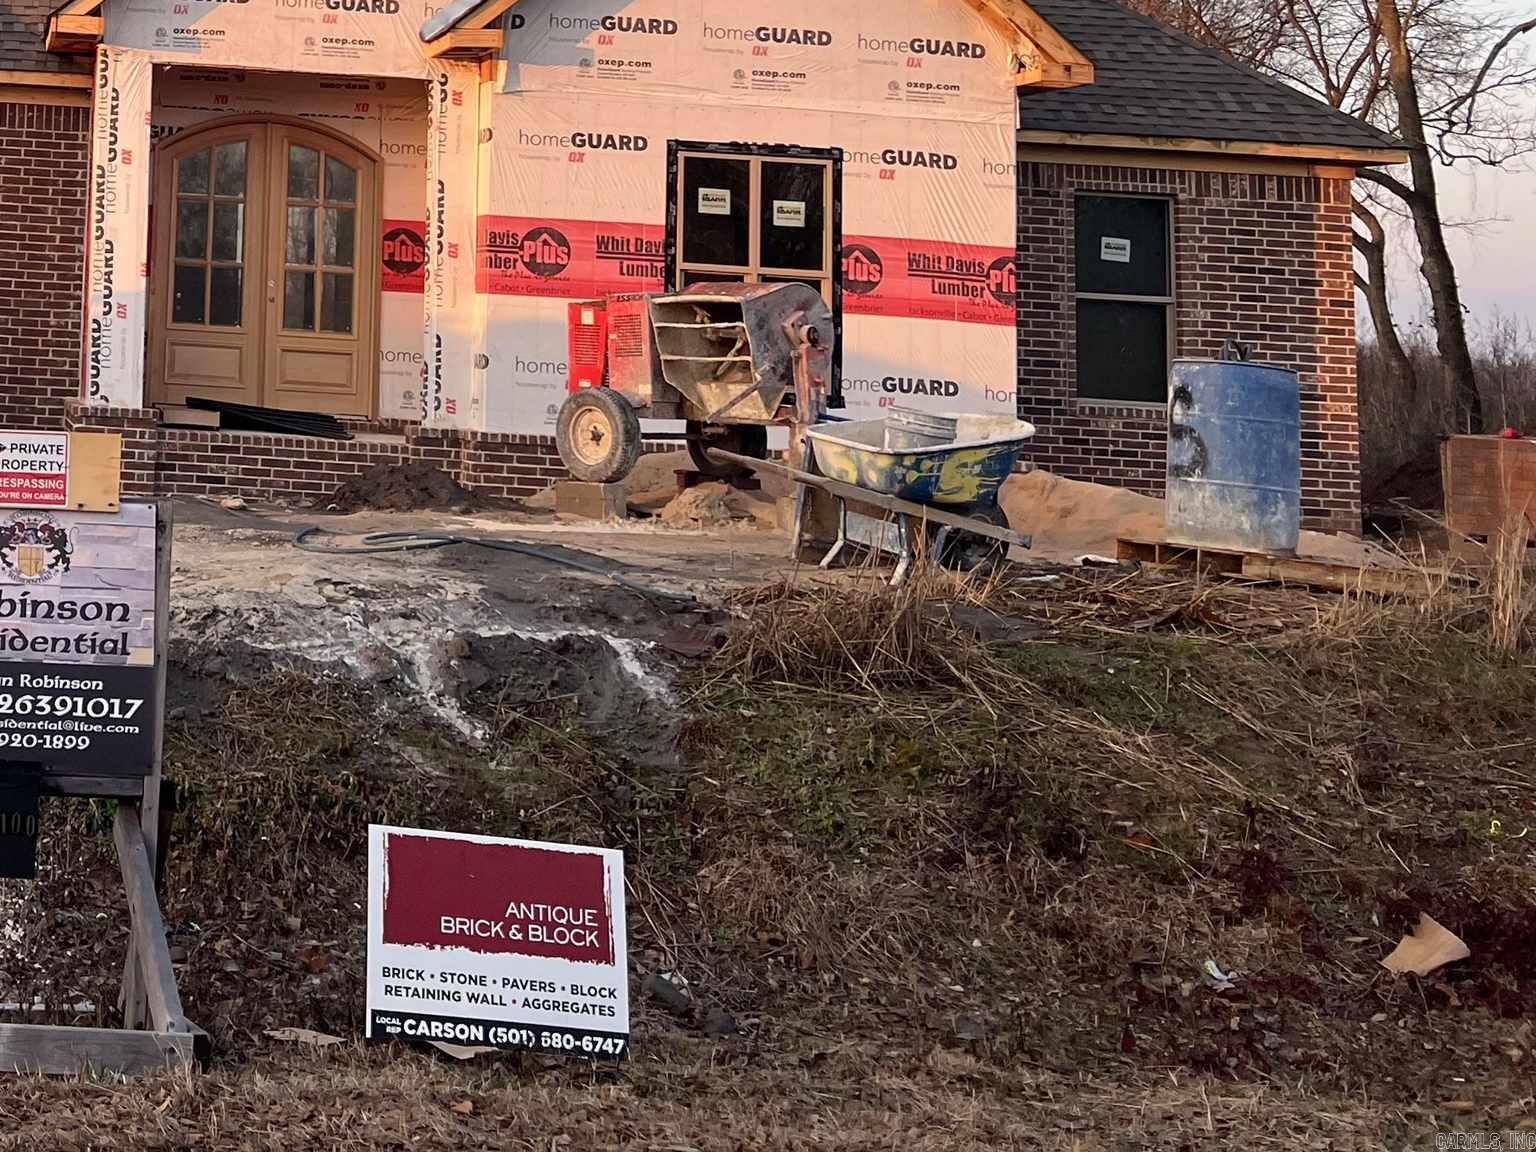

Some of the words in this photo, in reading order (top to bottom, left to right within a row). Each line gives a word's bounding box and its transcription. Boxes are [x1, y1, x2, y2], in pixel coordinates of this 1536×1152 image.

[173, 4, 189, 16] OX
[322, 14, 338, 25] OX
[549, 13, 678, 35] homeGUARD
[173, 26, 226, 38] oxep.com
[598, 34, 615, 45] OX
[703, 22, 832, 47] homeGUARD
[322, 35, 375, 48] oxep.com
[857, 34, 986, 59] homeGUARD
[752, 45, 768, 56] OX
[598, 57, 652, 69] oxep.com
[906, 57, 923, 69] OX
[752, 68, 806, 80] oxep.com
[906, 80, 960, 93] oxep.com
[519, 128, 649, 152] homeGUARD
[568, 151, 585, 163] OX
[879, 169, 896, 180] OX
[486, 229, 520, 247] avis
[595, 234, 631, 252] Whit
[523, 234, 569, 265] Plus
[842, 252, 883, 283] lus
[907, 251, 943, 270] Whit
[945, 255, 986, 275] Davis
[931, 279, 985, 299] Lumber
[10, 443, 65, 456] PRIVATE
[21, 492, 33, 500] ON
[34, 492, 65, 501] CAMERA
[19, 673, 104, 691] Robinson
[504, 901, 599, 927] ANTIQUE
[440, 916, 505, 939] BRICK
[508, 924, 524, 940] &
[528, 924, 600, 948] BLOCK
[381, 966, 426, 981] BRICK
[439, 971, 488, 987] STONE
[501, 977, 557, 994] PAVERS
[570, 983, 618, 1000] BLOCK
[384, 984, 462, 1003] RETAINING
[466, 991, 508, 1007] WALL
[521, 997, 617, 1018] AGGREGATES
[375, 1015, 403, 1027] LOCAL
[385, 1024, 402, 1034] REP
[403, 1018, 484, 1042] CARSON
[488, 1025, 536, 1048] (501)
